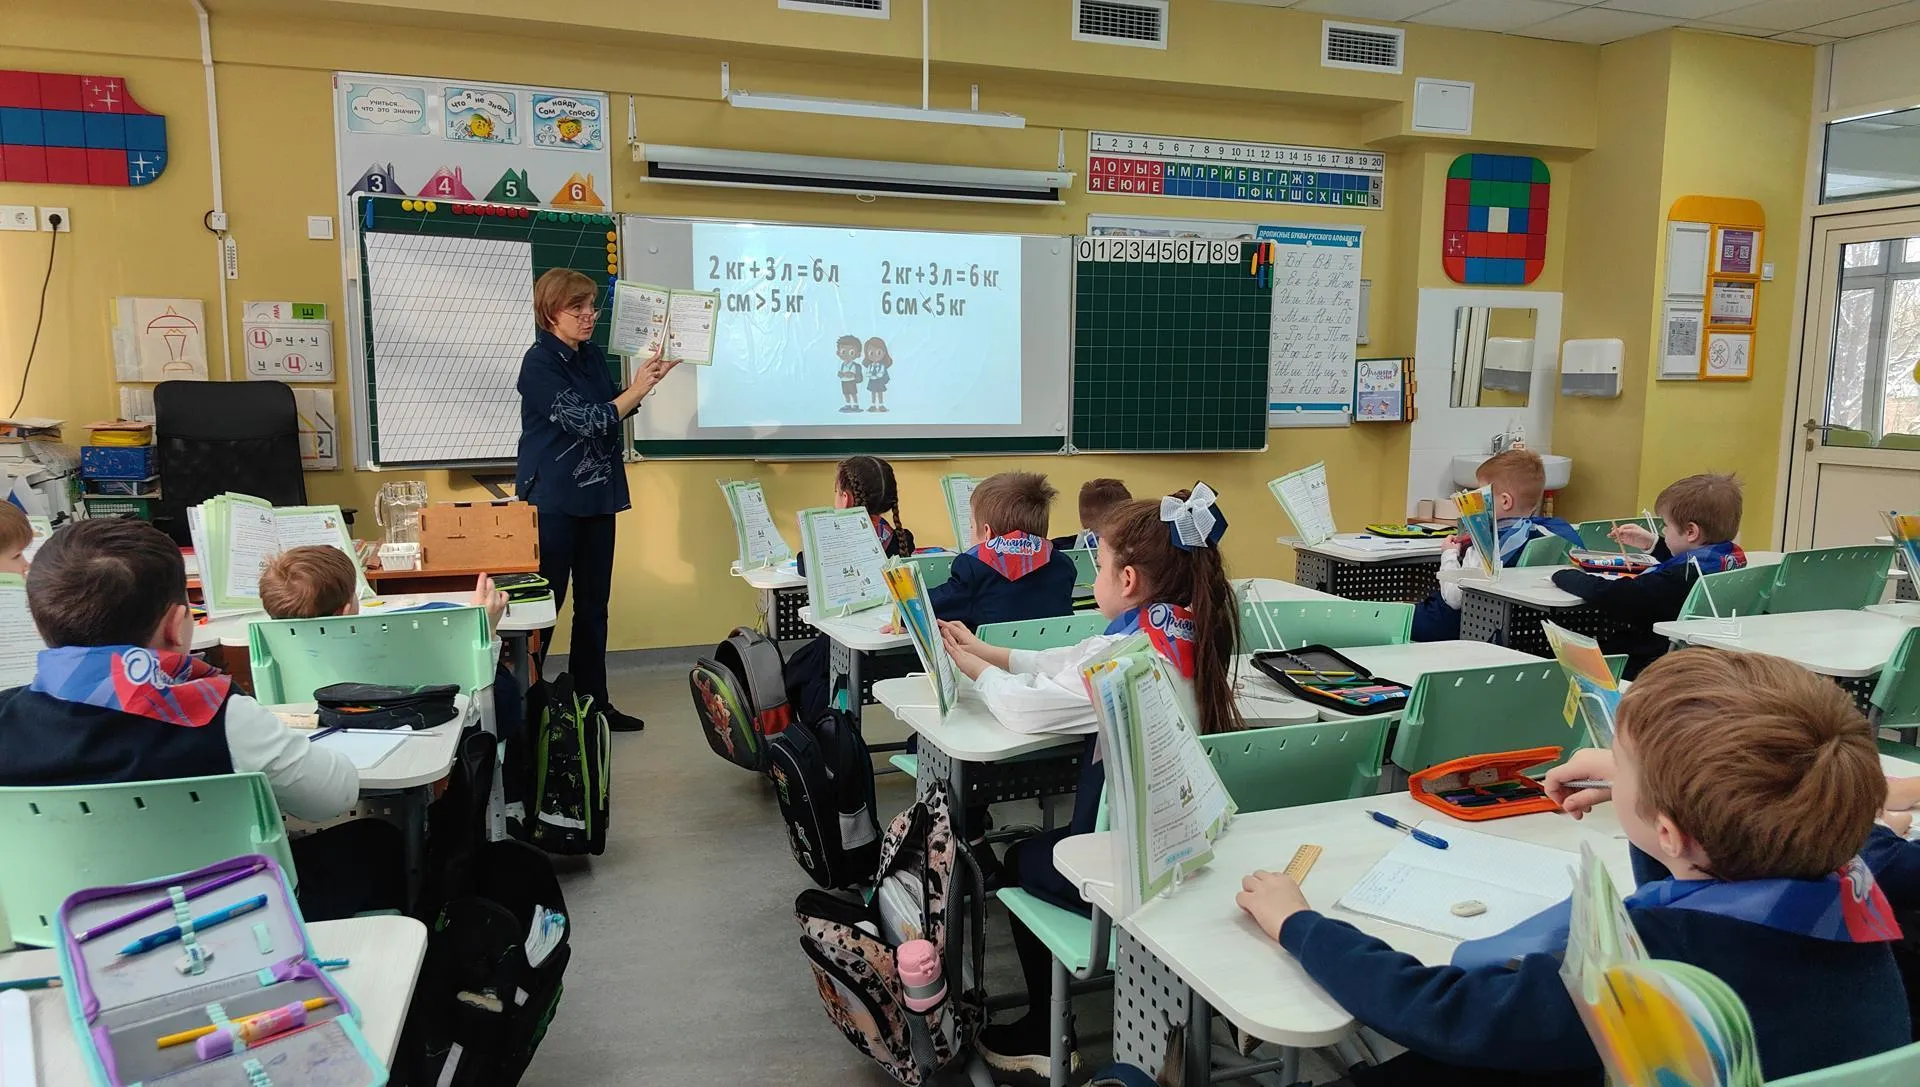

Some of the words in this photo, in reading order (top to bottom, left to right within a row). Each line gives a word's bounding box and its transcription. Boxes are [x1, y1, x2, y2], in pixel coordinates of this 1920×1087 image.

[552, 100, 577, 108] найду
[568, 108, 596, 117] способ
[1097, 138, 1101, 146] 1
[1112, 139, 1118, 147] 2
[1128, 140, 1133, 148] 3
[1143, 141, 1148, 149] 4
[1159, 142, 1164, 150] 5
[1174, 143, 1179, 151] 6
[1204, 146, 1209, 154] 8
[1219, 146, 1224, 155] 9
[1232, 148, 1240, 156] 10
[1247, 149, 1255, 157] 11
[1261, 150, 1270, 158] 12
[1275, 151, 1284, 159] 13
[1290, 152, 1298, 160] 14
[1304, 153, 1312, 161] 15
[1318, 154, 1326, 162] 16
[1332, 155, 1340, 163] 17
[1345, 156, 1354, 164] 18
[1359, 157, 1367, 165] 19
[1372, 158, 1380, 166] 20
[1093, 161, 1100, 171] А
[1108, 162, 1116, 172] О
[1124, 163, 1131, 173] У
[1137, 164, 1147, 174] Ы
[1152, 165, 1160, 175] Э
[1168, 166, 1175, 176] Н
[1181, 166, 1190, 177] М
[1196, 168, 1203, 178] Л
[1211, 169, 1218, 179] Р
[1225, 168, 1232, 179] Й
[1239, 170, 1246, 181] Б
[1252, 171, 1260, 181] В
[1267, 172, 1273, 182] Г
[1279, 173, 1287, 185] Д
[1292, 174, 1302, 184] Ж
[1307, 175, 1314, 185] З
[371, 175, 383, 193] 3
[438, 178, 451, 194] 4
[506, 181, 517, 197] 5
[572, 184, 583, 200] 6
[1092, 178, 1100, 188] Я
[1108, 177, 1115, 189] Ё
[1121, 180, 1132, 190] Ю
[1137, 181, 1145, 190] И
[1153, 182, 1159, 192] Е
[1238, 187, 1245, 197] П
[1251, 187, 1260, 197] Ф
[1266, 188, 1272, 198] К
[1280, 189, 1286, 199] Т
[1292, 190, 1301, 200] Ш
[1306, 191, 1313, 201] С
[1320, 192, 1326, 201] Х
[1332, 192, 1340, 204] Ц
[1346, 193, 1352, 203] Ч
[1357, 194, 1368, 206] Щ
[1260, 230, 1290, 239] ПРОПИСНЫЕ
[1291, 231, 1308, 239] БУКВЫ
[1308, 233, 1332, 241] РУССКОГО
[709, 255, 720, 279] 2
[726, 262, 745, 280] кг
[766, 257, 776, 280] 3
[781, 263, 792, 281] л
[813, 258, 823, 282] 6
[828, 264, 839, 282] л
[882, 260, 891, 284] 2
[896, 267, 912, 284] кг
[929, 262, 938, 285] 3
[942, 269, 952, 286] л
[970, 264, 979, 287] 6
[984, 270, 999, 287] кг
[727, 294, 750, 312] см
[771, 289, 780, 313] 5
[786, 294, 803, 312] кг
[882, 291, 891, 315] 6
[896, 297, 918, 315] см
[936, 293, 945, 316] 5
[950, 299, 966, 316] кг
[254, 332, 267, 346] Ц
[288, 357, 301, 371] Ц
